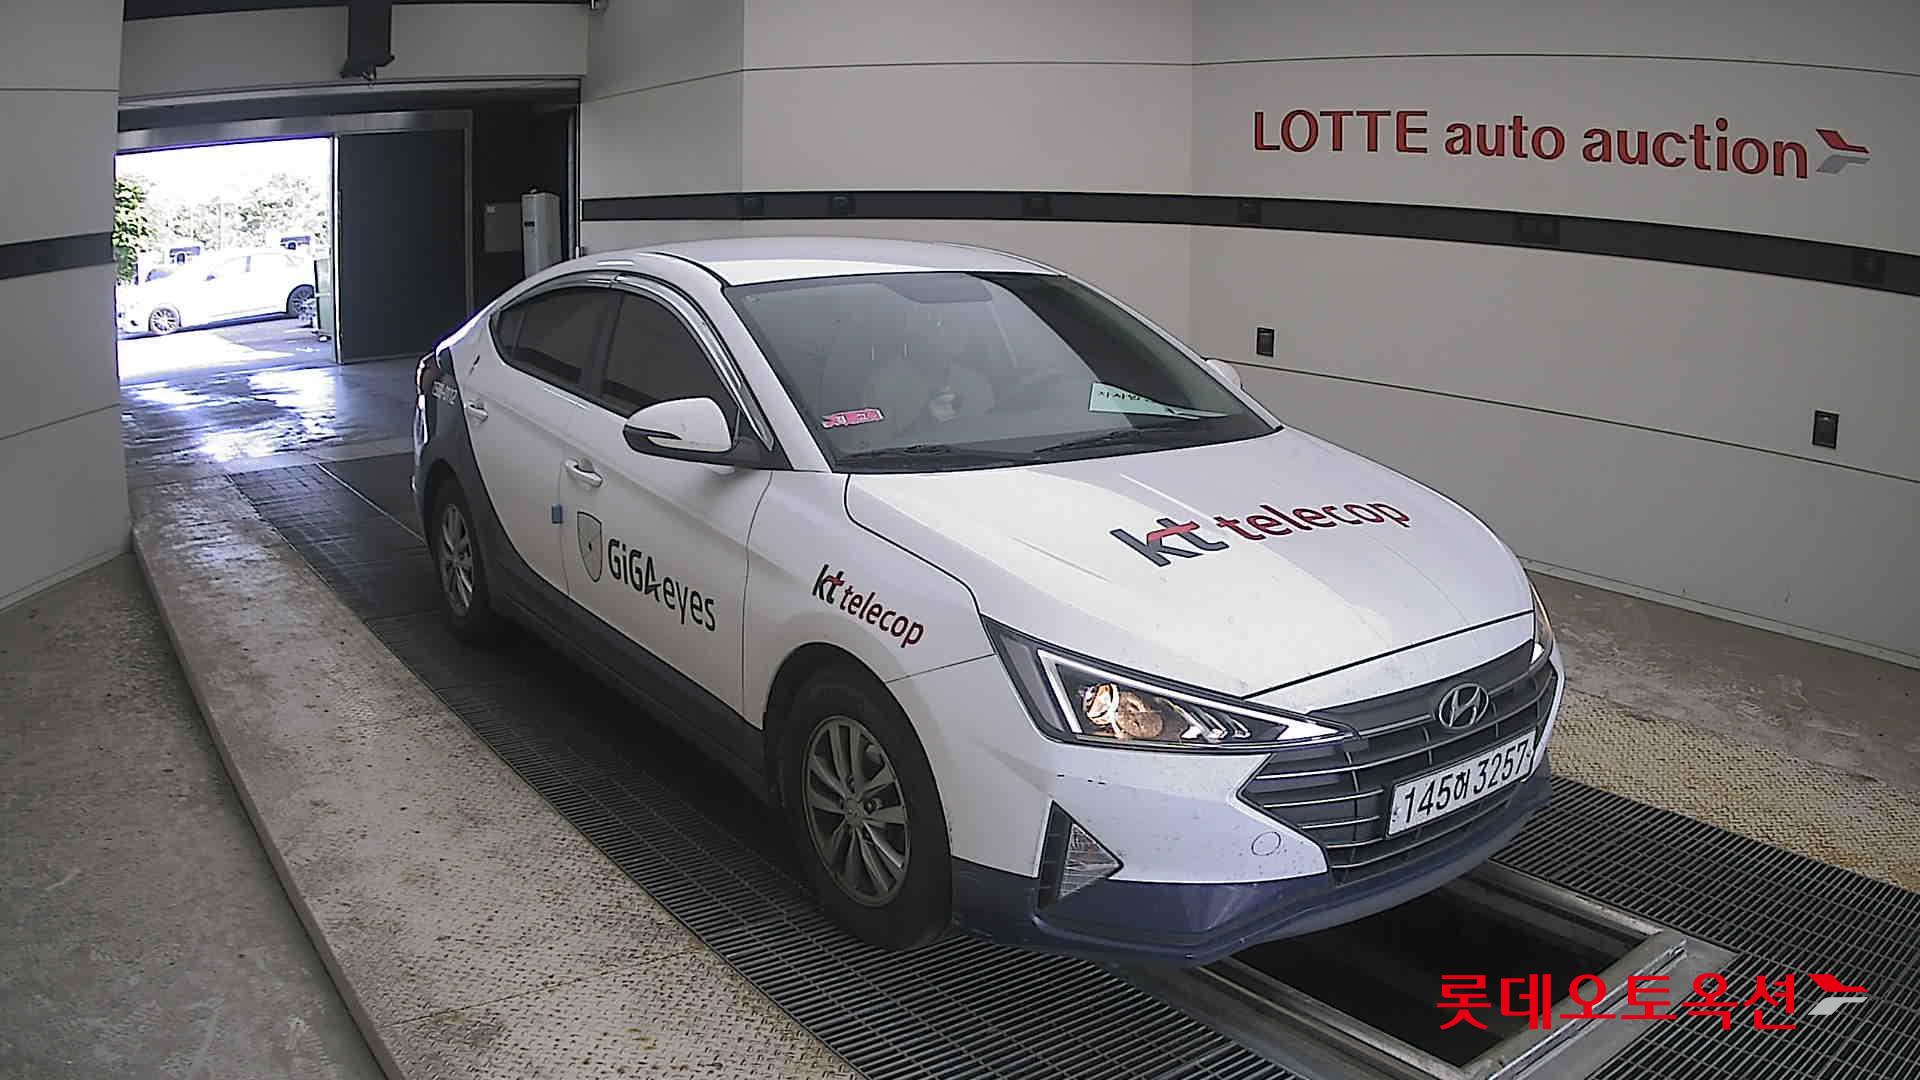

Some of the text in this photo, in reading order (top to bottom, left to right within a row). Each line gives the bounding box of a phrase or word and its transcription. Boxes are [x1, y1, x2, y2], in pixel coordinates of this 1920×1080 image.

[1253, 109, 1809, 180] LOTTE auto auction
[1110, 503, 1411, 567] kt telecop
[812, 564, 925, 649] kt telecop
[1473, 739, 1530, 795] 3257
